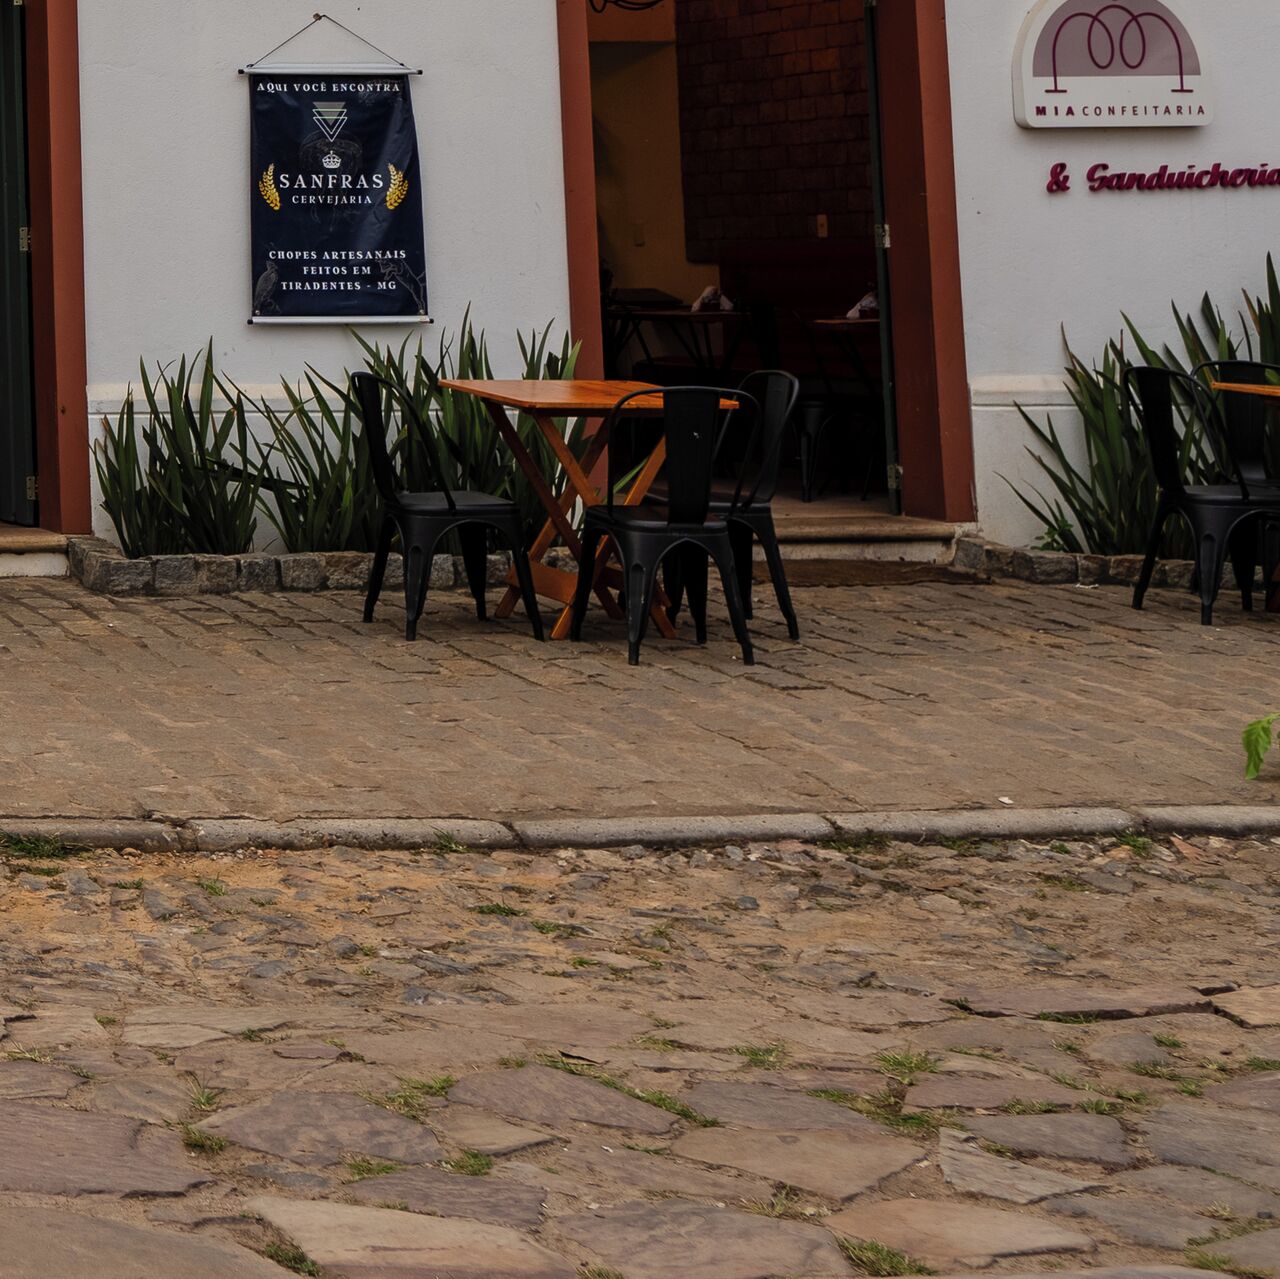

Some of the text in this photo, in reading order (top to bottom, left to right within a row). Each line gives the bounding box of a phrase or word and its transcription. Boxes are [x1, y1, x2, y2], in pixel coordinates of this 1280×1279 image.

[257, 82, 400, 92] AQUI VOCÊ ENCONTRA
[1036, 105, 1205, 116] MIA CONFEITARIA
[280, 174, 384, 189] SANFRAS
[1046, 163, 1280, 193] & Sanduicheria
[292, 196, 372, 205] CERVEJARIA
[269, 250, 406, 260] CHOPES ARTESANAIS
[303, 266, 371, 275] FEITOS EM
[281, 282, 361, 291] TIRADENTES
[377, 282, 397, 291] MG
